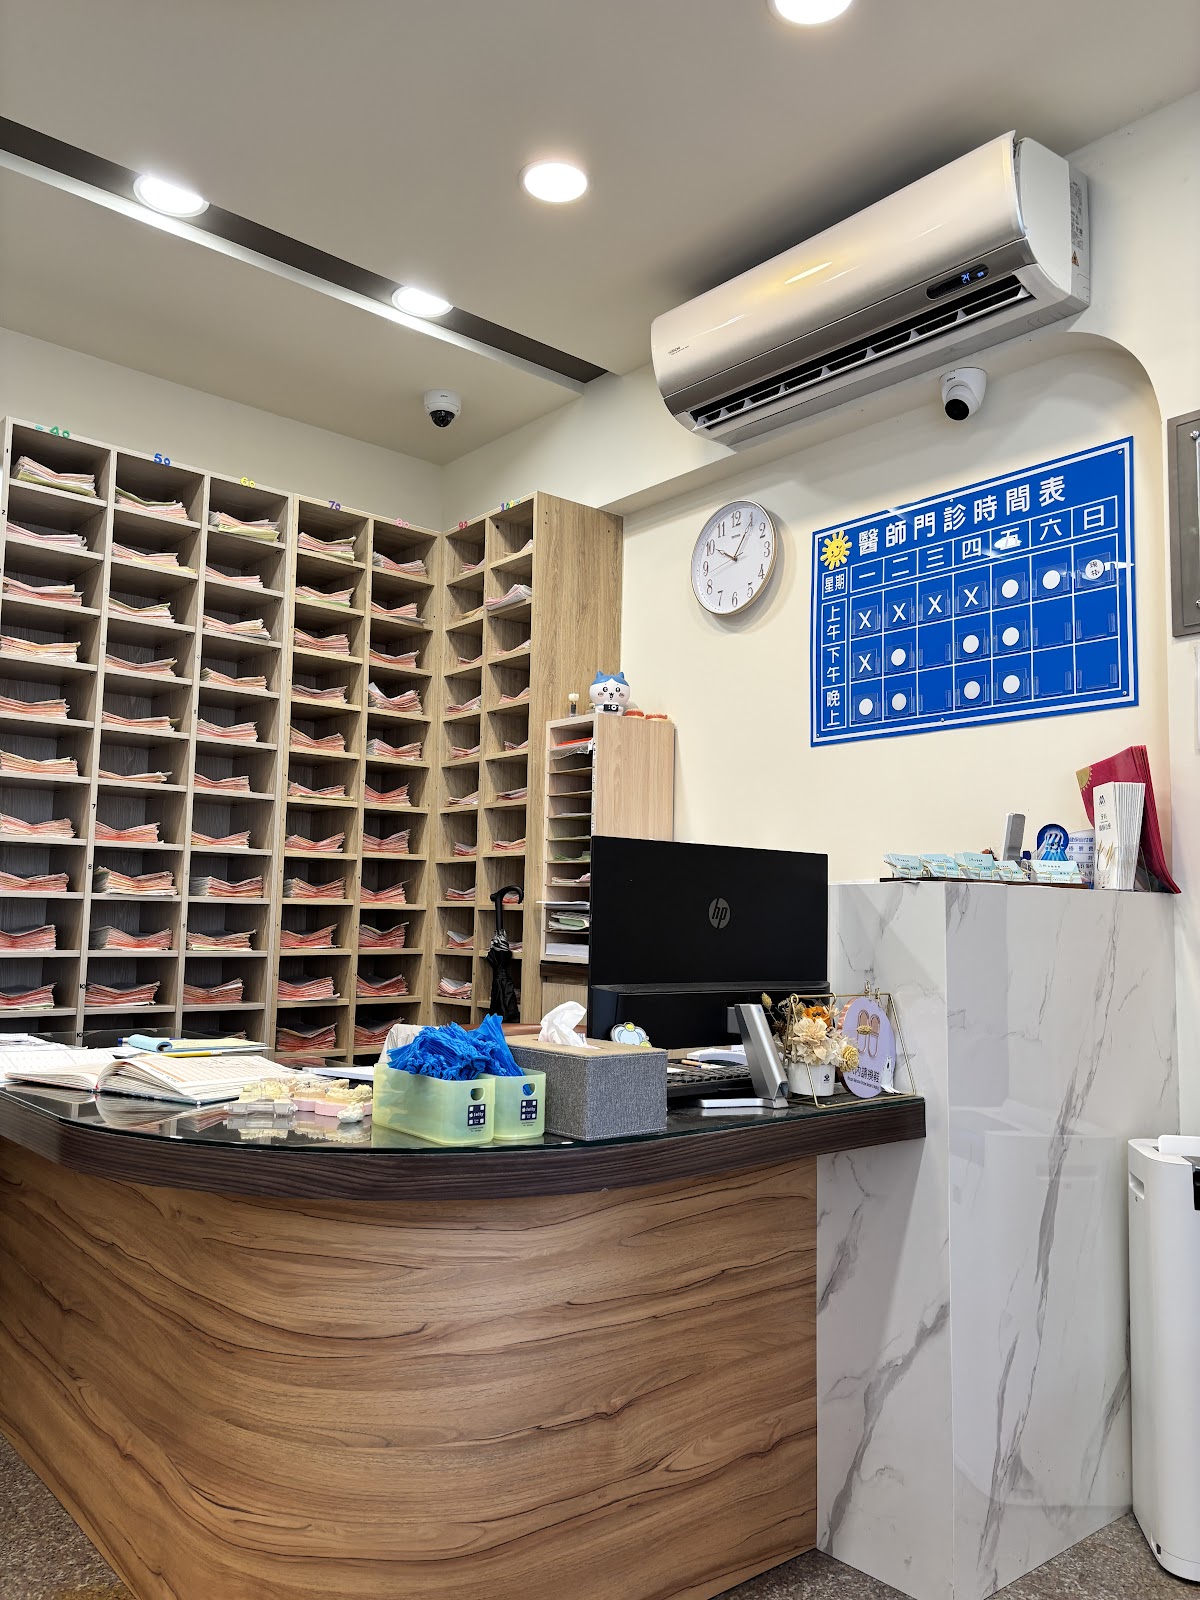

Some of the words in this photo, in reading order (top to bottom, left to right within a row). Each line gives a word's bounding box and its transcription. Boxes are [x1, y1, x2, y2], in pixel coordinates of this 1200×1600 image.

[153, 453, 171, 467] 50
[241, 477, 256, 488] 60
[328, 500, 341, 511] 70
[395, 518, 410, 529] 80
[731, 510, 741, 528] 12
[858, 475, 1066, 556] 醫師門診時間表
[717, 521, 726, 538] 11
[759, 522, 766, 539] 2
[706, 539, 716, 556] 10
[763, 541, 771, 557] 3
[824, 574, 845, 593] 星期
[892, 556, 910, 577] 二
[926, 547, 945, 569] 三
[961, 537, 982, 560] 四
[1039, 518, 1063, 541] 六
[1083, 504, 1105, 530] 日
[702, 561, 709, 576] 9
[758, 563, 765, 579] 4
[706, 579, 713, 595] 8
[747, 582, 753, 598] 5
[717, 590, 724, 606] 7
[731, 591, 738, 607] 6
[827, 606, 841, 640] 上午
[827, 647, 841, 682] 下午
[826, 690, 840, 727] 晚上
[711, 898, 729, 929] hp
